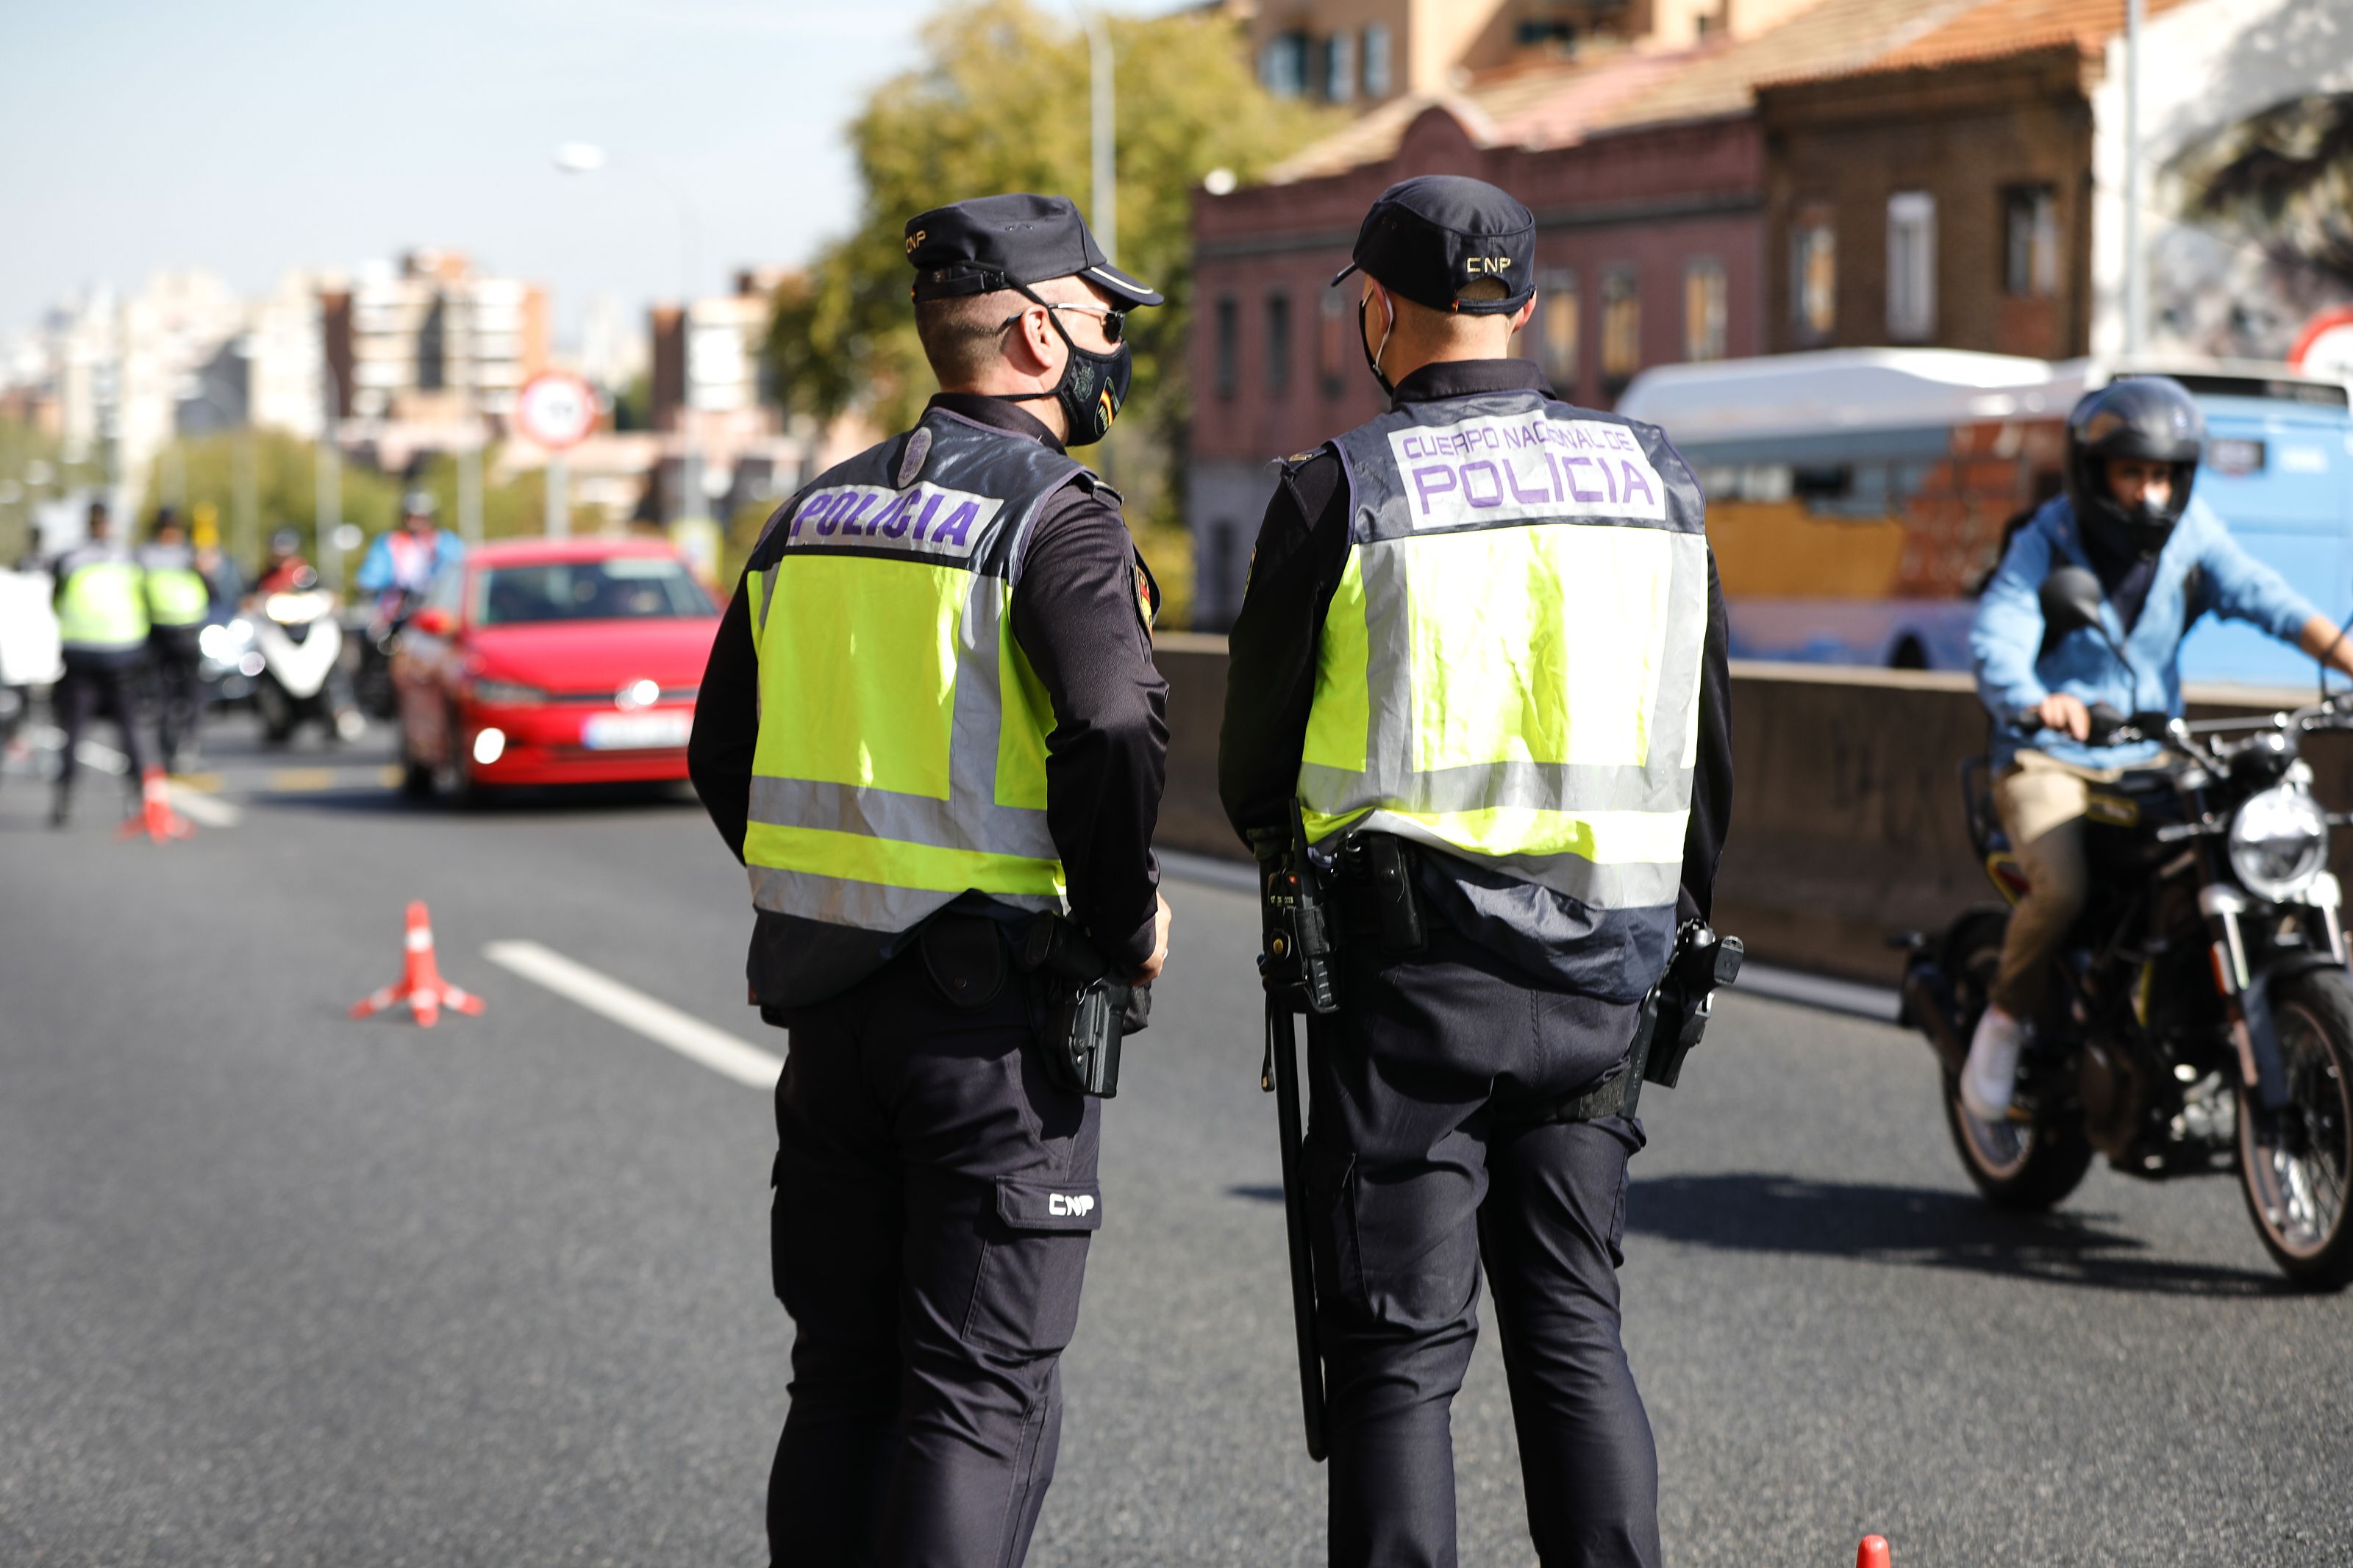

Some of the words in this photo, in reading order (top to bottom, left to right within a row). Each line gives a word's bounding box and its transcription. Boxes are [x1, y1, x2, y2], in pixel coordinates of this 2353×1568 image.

[905, 230, 926, 254] CNP
[1466, 257, 1512, 273] CNP
[1402, 426, 1500, 459] CUERPO
[1602, 429, 1635, 451] DE
[1413, 452, 1654, 515] POLICIA
[789, 488, 981, 547] POLICIA
[1049, 1192, 1095, 1217] CNP
